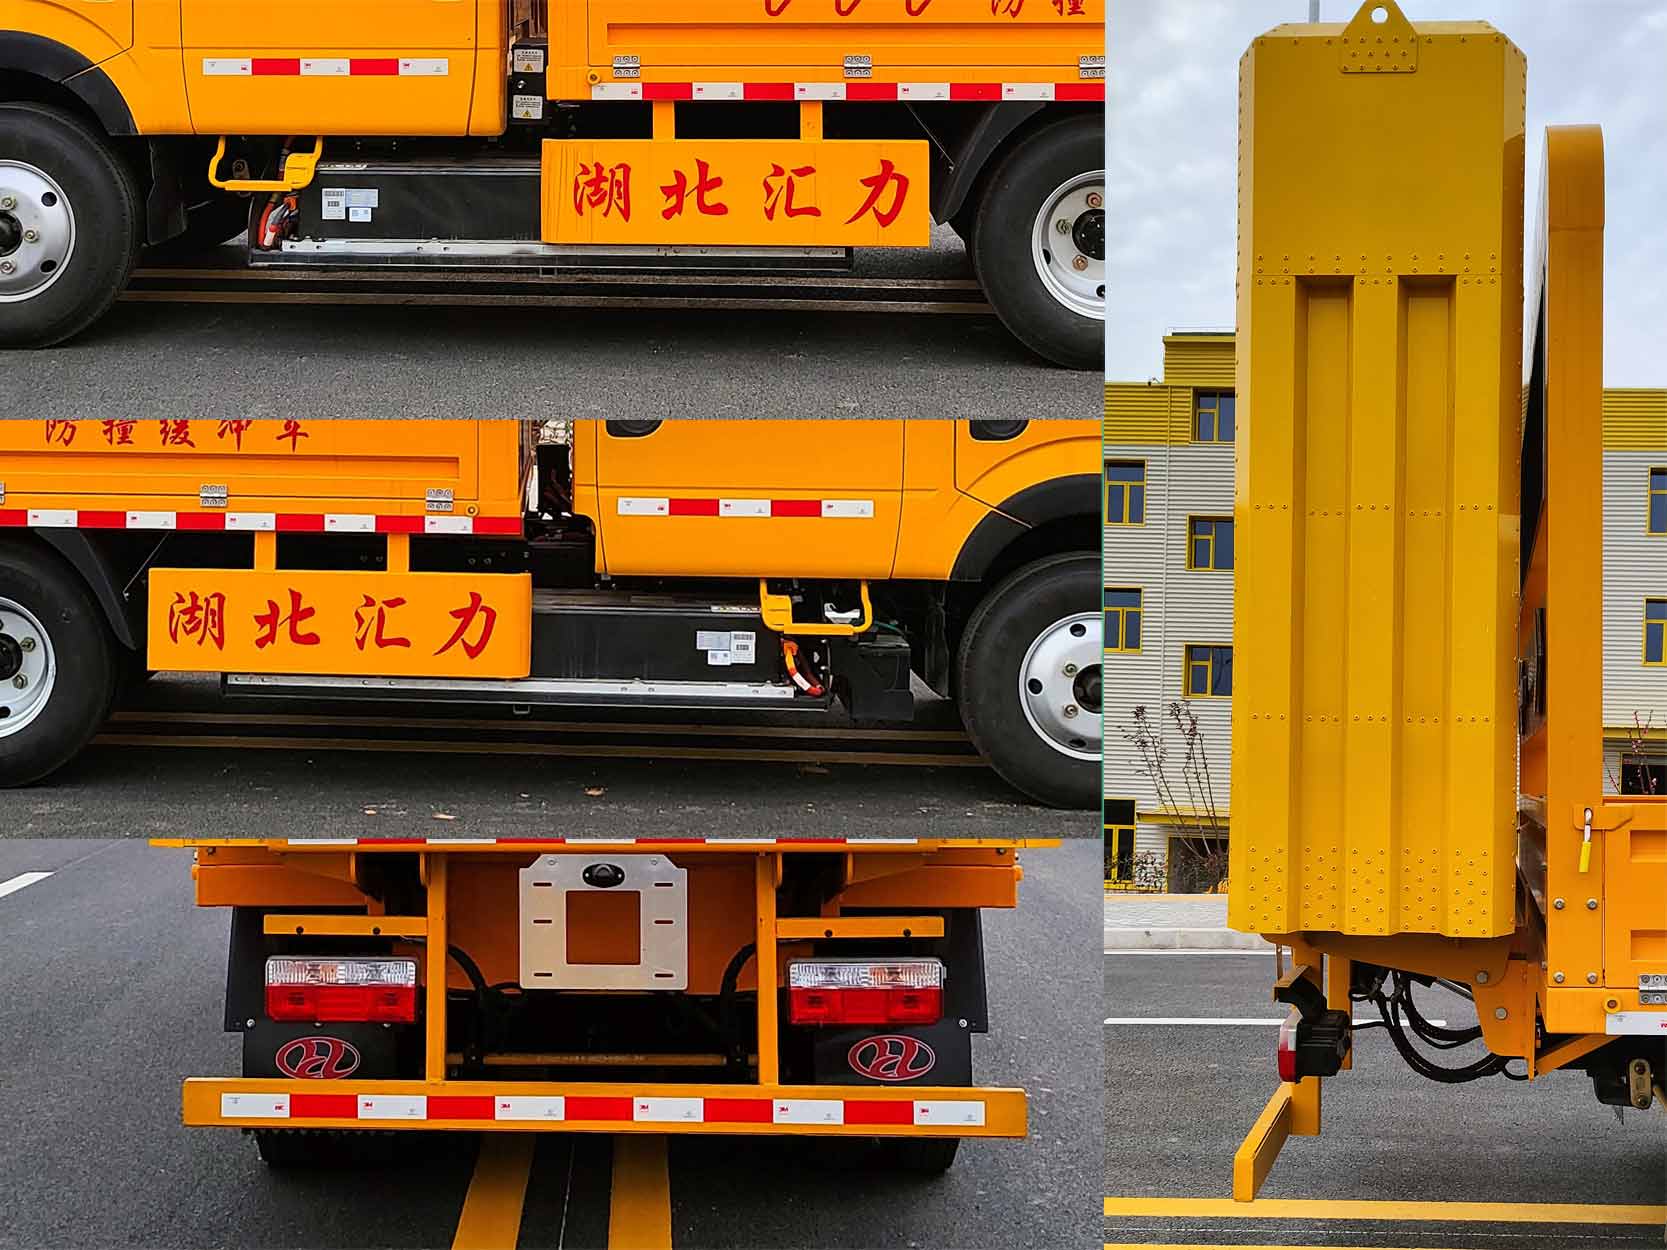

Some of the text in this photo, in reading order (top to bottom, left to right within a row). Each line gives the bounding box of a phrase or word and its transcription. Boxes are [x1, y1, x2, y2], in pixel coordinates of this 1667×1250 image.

[573, 158, 910, 229] 湖北汇力
[168, 587, 497, 660] 湖北汇力
